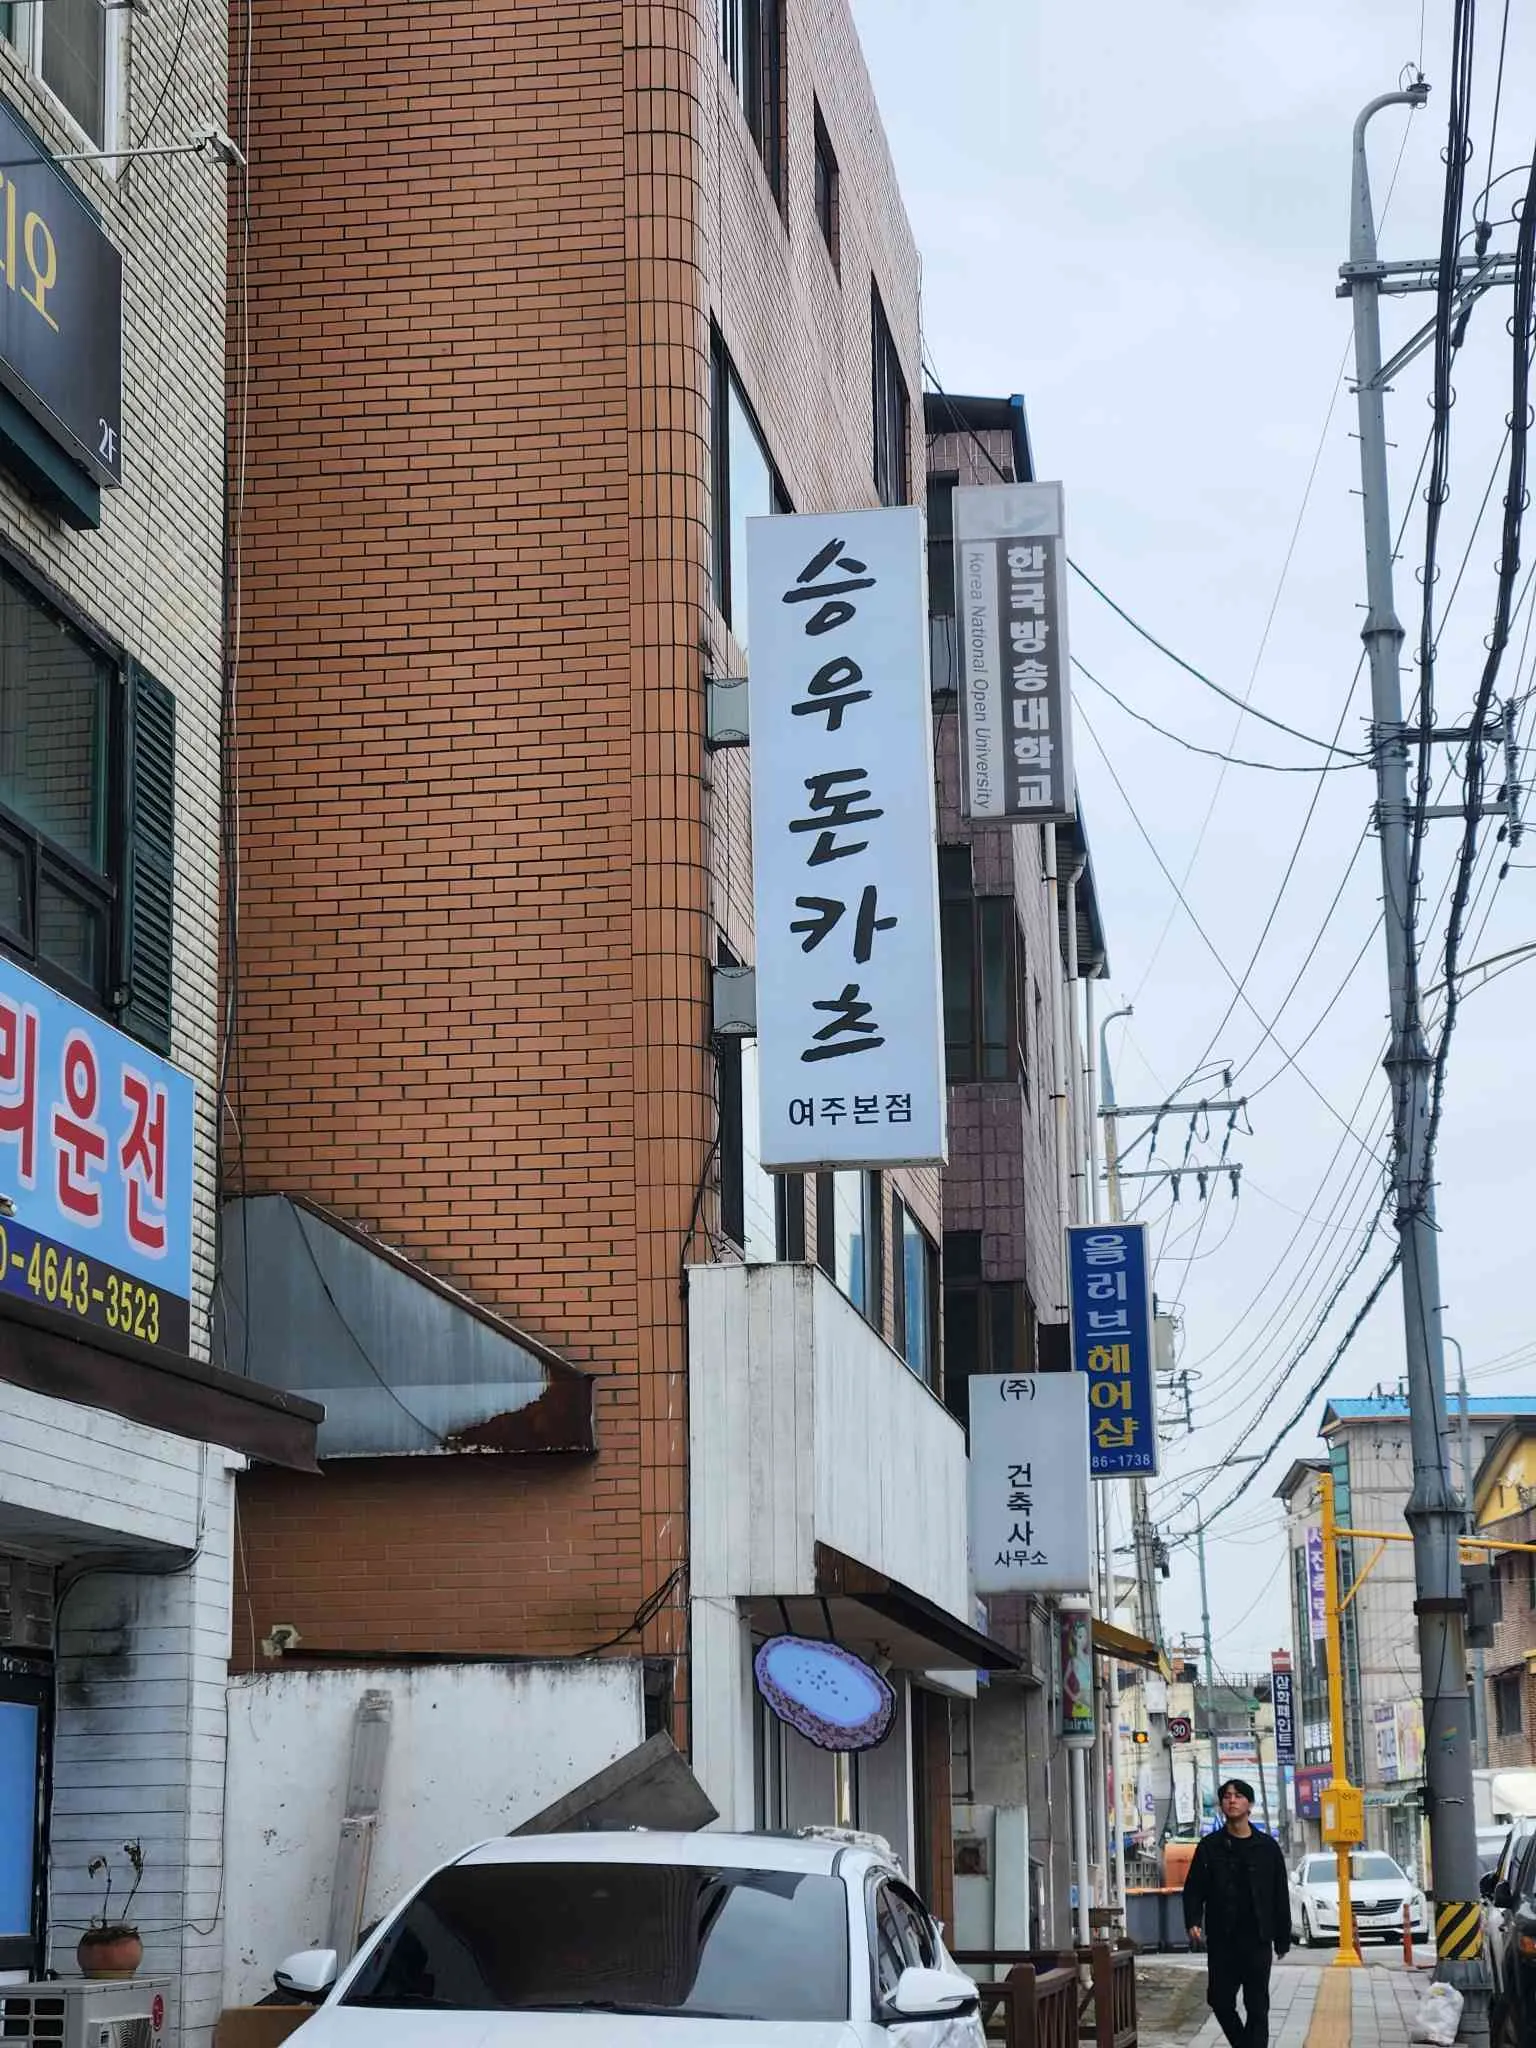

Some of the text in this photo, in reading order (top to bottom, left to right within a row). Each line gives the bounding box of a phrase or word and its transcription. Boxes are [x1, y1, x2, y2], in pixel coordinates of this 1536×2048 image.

[99, 417, 118, 465] 2F
[968, 552, 993, 809] Korea National Open University
[1007, 545, 1054, 808] 한국방송대학교
[781, 538, 898, 1063] 승우돈카츠
[0, 1002, 168, 1249] 리운전
[999, 1379, 1036, 1402] (주)
[1006, 1462, 1034, 1547] 건축사
[994, 1550, 1049, 1569] 사무소
[1172, 1724, 1186, 1737] 30
